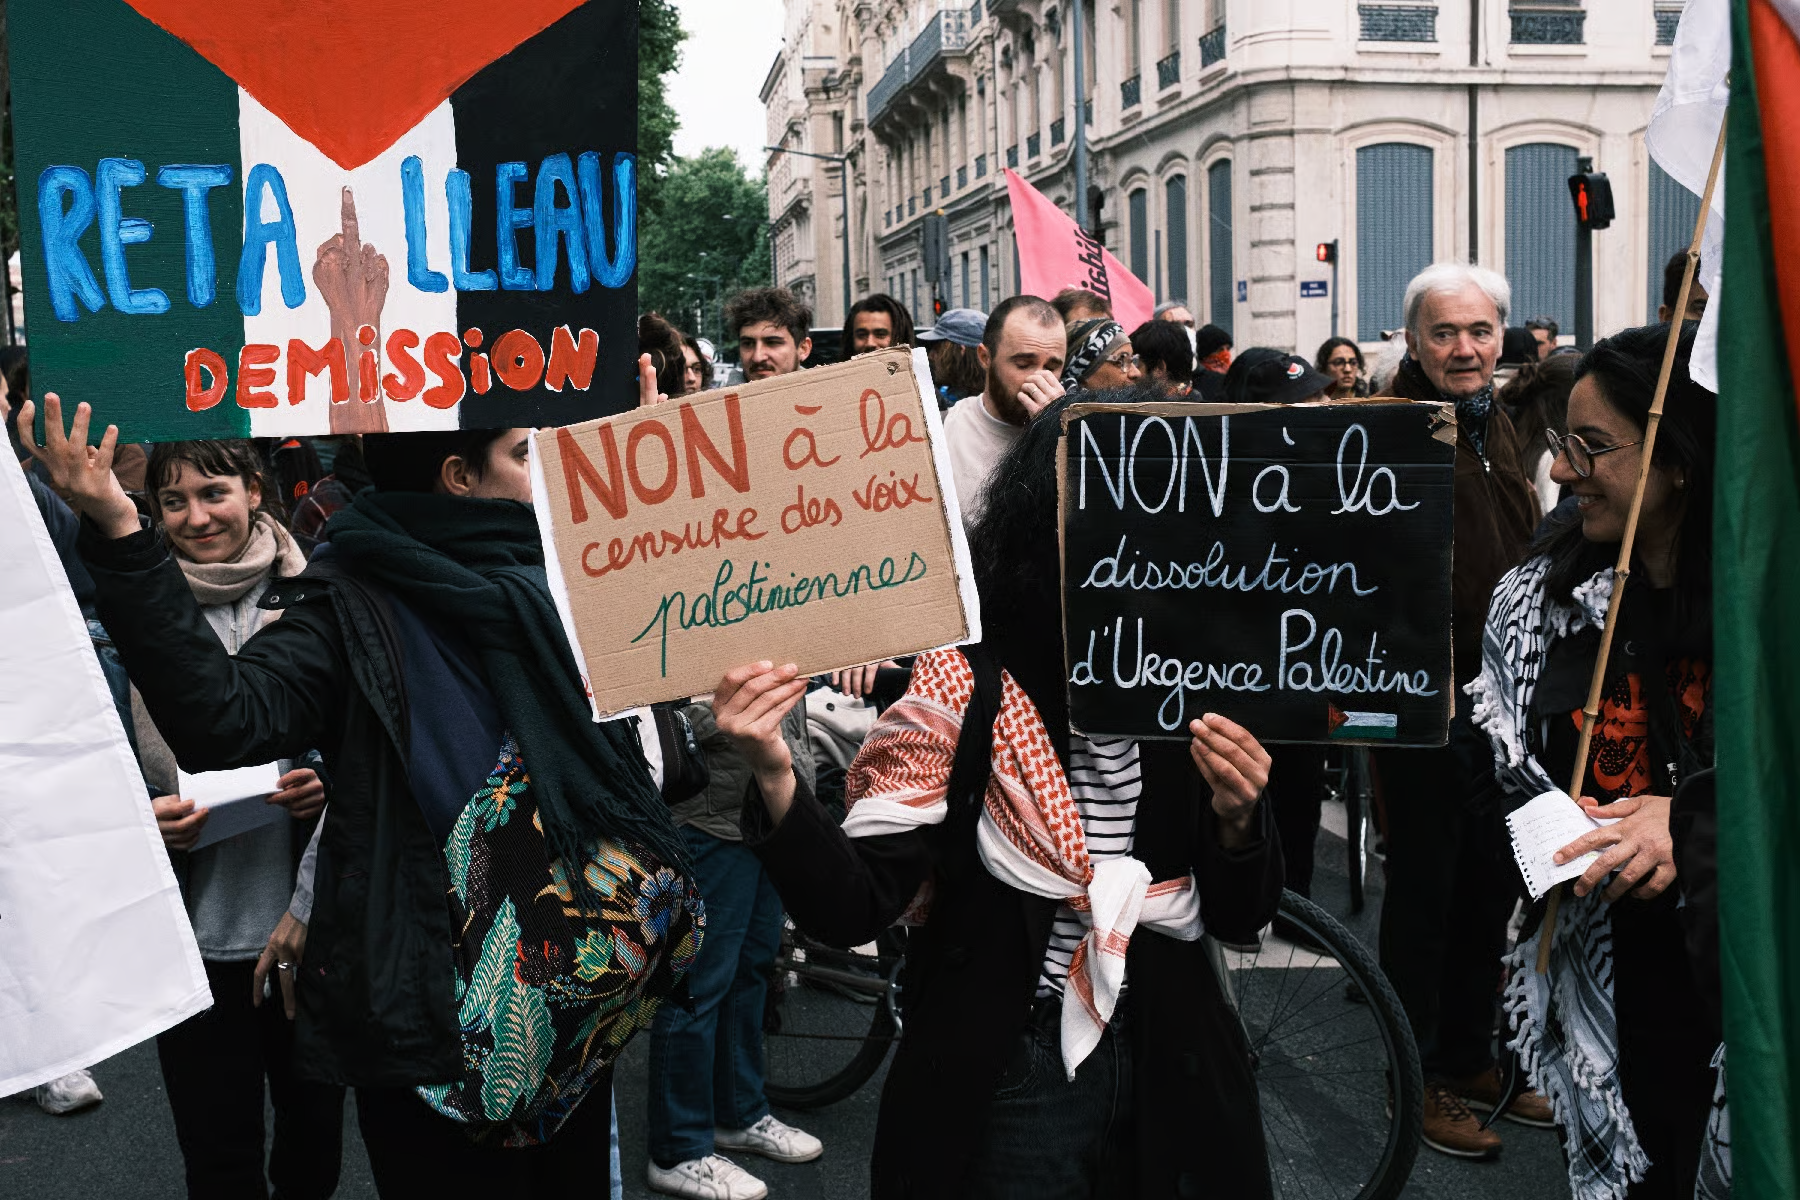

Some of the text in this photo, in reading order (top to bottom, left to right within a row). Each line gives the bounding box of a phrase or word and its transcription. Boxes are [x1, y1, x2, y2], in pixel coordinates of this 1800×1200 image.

[556, 388, 925, 525] NON à la
[780, 485, 843, 536] des
[852, 470, 933, 513] voix
[1078, 414, 1421, 518] NON à la
[1080, 534, 1380, 597] dissolution
[631, 552, 927, 678] palestiniennes
[1278, 608, 1440, 696] Palestine
